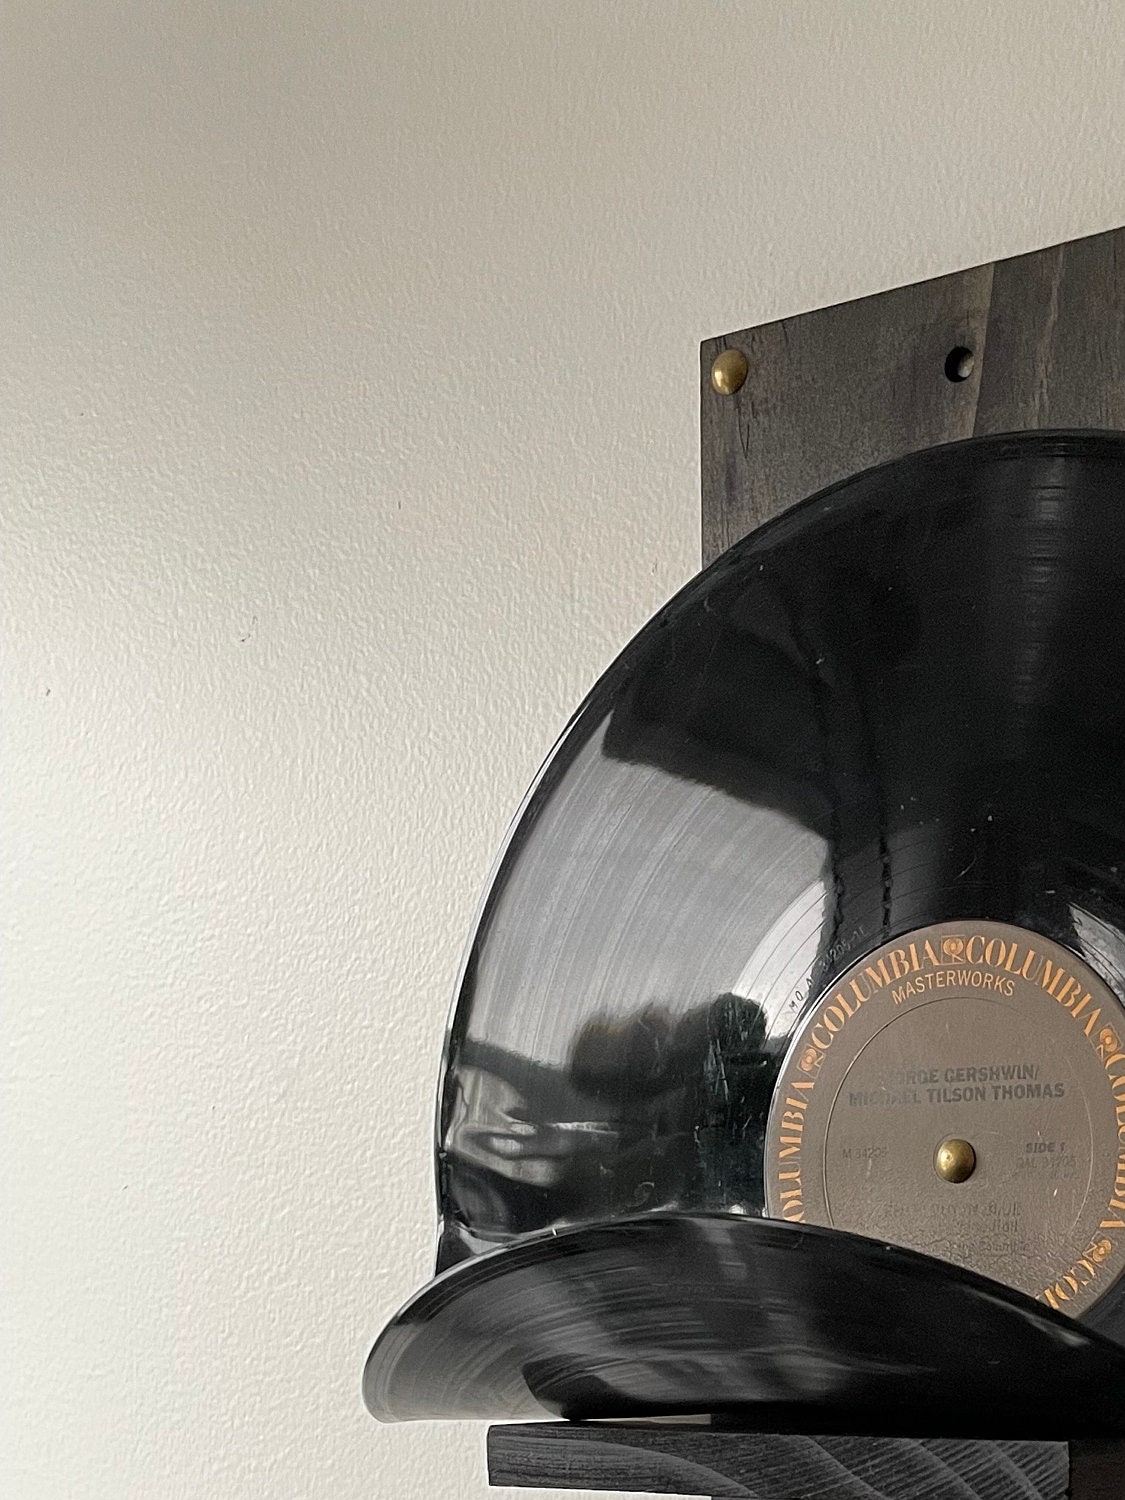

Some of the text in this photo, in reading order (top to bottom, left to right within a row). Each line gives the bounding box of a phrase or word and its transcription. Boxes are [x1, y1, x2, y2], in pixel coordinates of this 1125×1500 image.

[811, 939, 941, 1050] COLUMBIA
[891, 969, 1016, 1005] MASTERWORKS
[964, 935, 1102, 1037] COLUMBIA
[944, 1063, 1040, 1084] GERSHWIN/
[926, 1086, 987, 1104] TILSON
[992, 1082, 1066, 1102] THOMAS
[778, 1081, 816, 1223] OLUMBIA
[1025, 1142, 1056, 1154] SIDE
